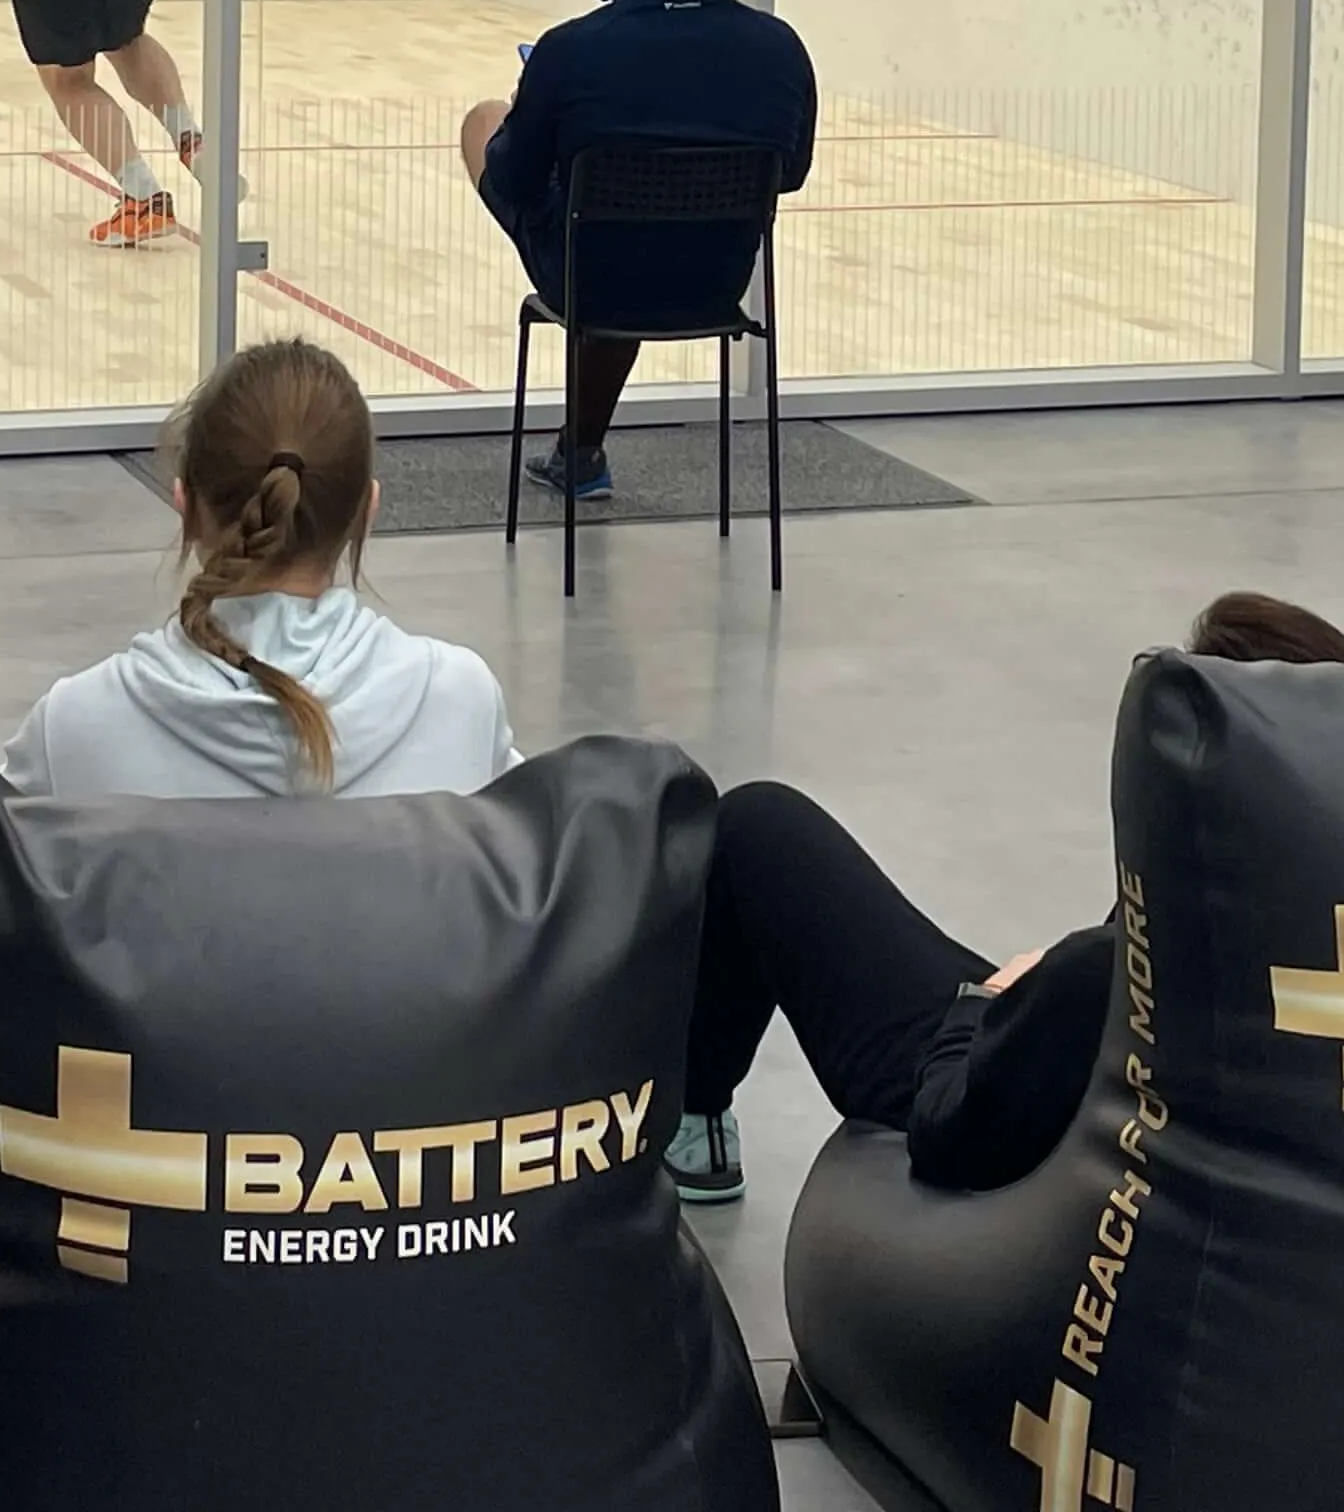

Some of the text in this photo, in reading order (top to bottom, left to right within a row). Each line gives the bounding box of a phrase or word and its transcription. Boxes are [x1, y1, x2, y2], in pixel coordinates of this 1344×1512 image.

[224, 1078, 654, 1214] BATTERY
[1062, 861, 1170, 1377] REACH FOR MORE
[223, 1210, 517, 1264] ENERGY DRINK
